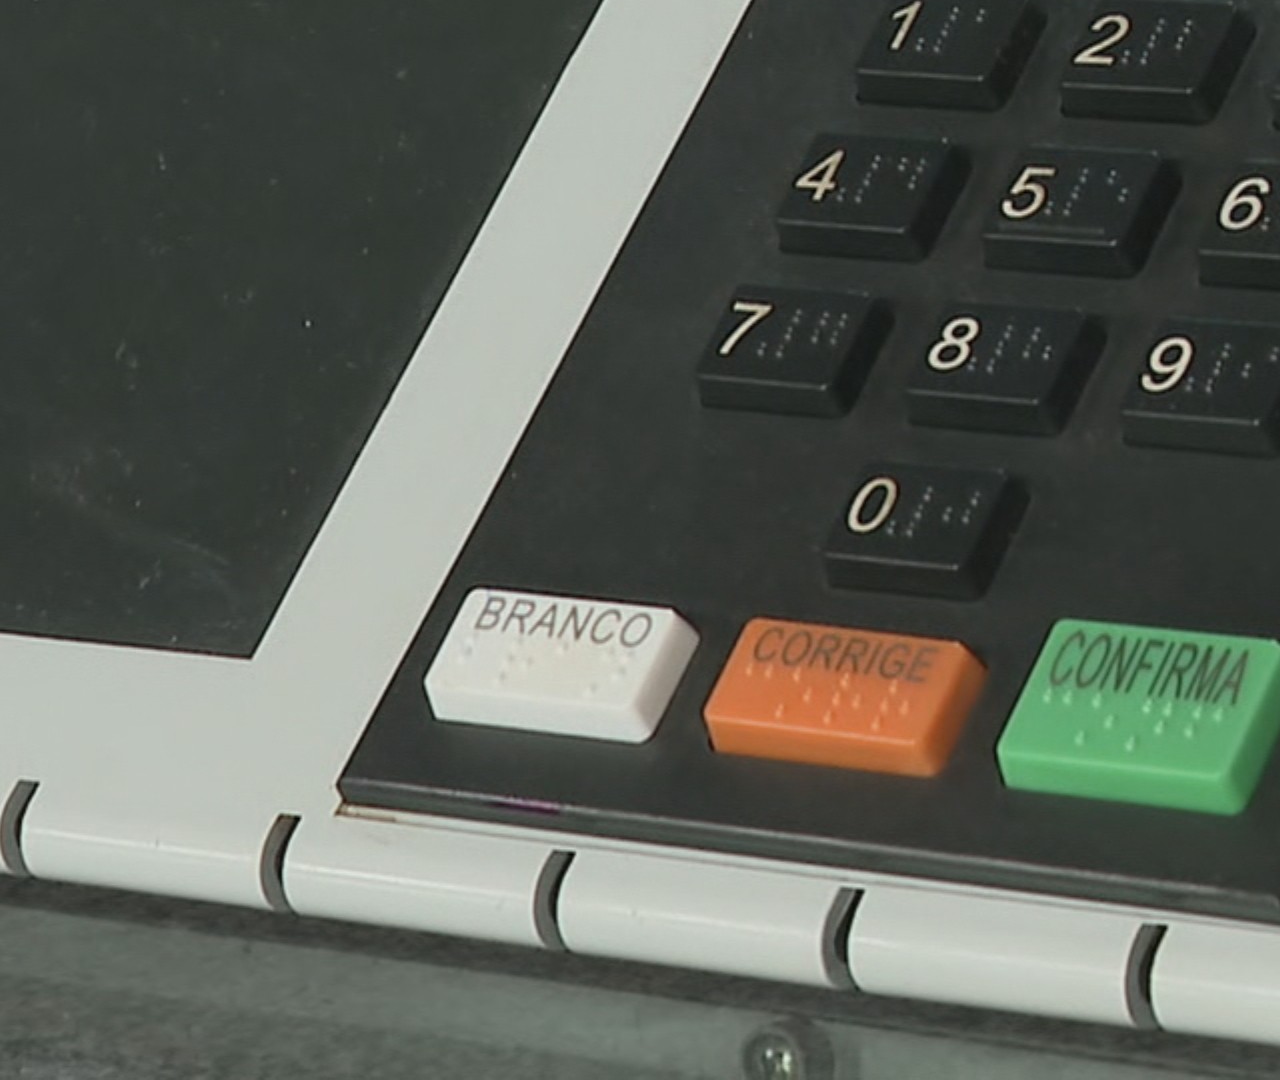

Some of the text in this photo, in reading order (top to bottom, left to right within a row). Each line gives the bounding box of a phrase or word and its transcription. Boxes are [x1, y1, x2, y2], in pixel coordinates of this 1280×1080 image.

[889, 0, 923, 51] 1
[1073, 14, 1131, 66] 2
[794, 149, 846, 202] 4
[1001, 166, 1056, 219] 5
[1218, 176, 1271, 231] 6
[718, 300, 773, 356] 7
[927, 316, 981, 371] 8
[1140, 336, 1194, 393] 9
[847, 477, 898, 534] 0
[474, 595, 654, 648] BRANCO
[753, 626, 940, 684] CORRIGE
[1049, 629, 1249, 706] CONFIRMA
